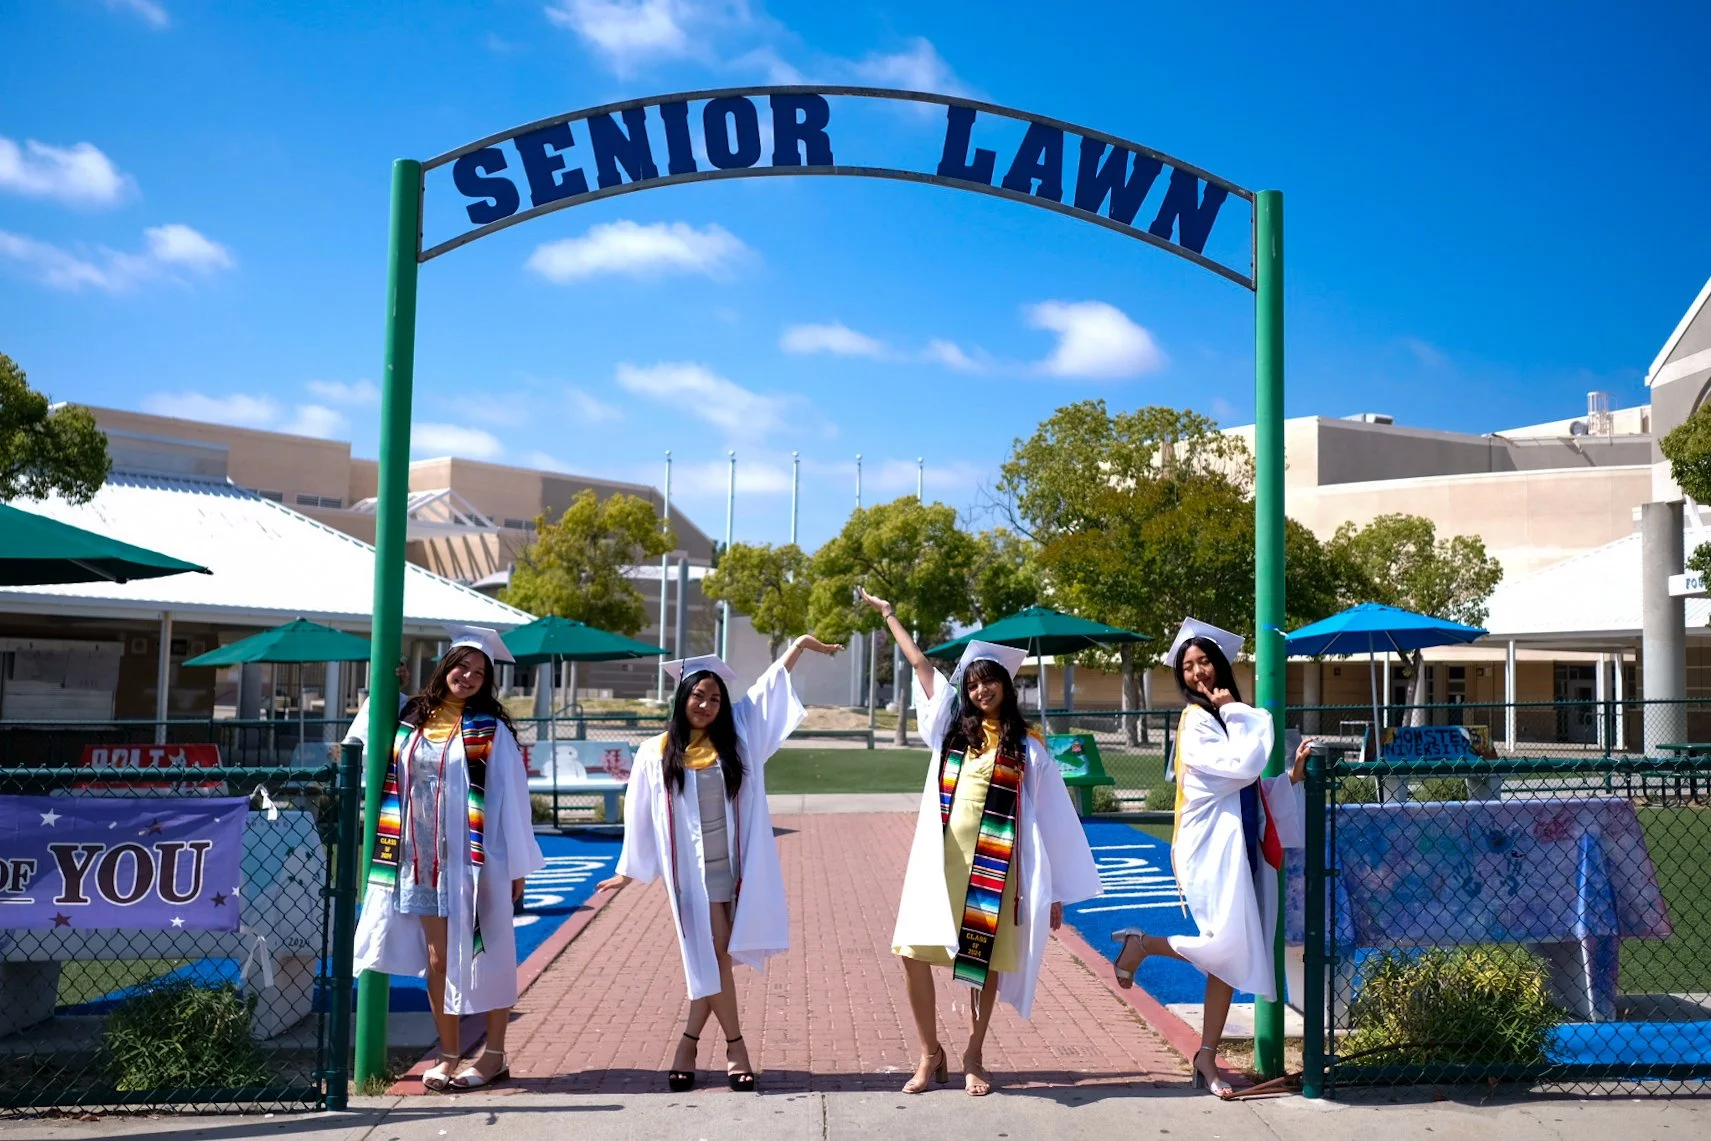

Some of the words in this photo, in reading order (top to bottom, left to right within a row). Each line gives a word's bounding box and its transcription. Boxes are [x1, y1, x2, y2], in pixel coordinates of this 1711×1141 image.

[452, 93, 834, 225] SENIOR
[937, 104, 1229, 255] LAWN
[1685, 577, 1704, 590] FOU
[47, 840, 213, 907] YOU
[966, 932, 988, 944] CLASS
